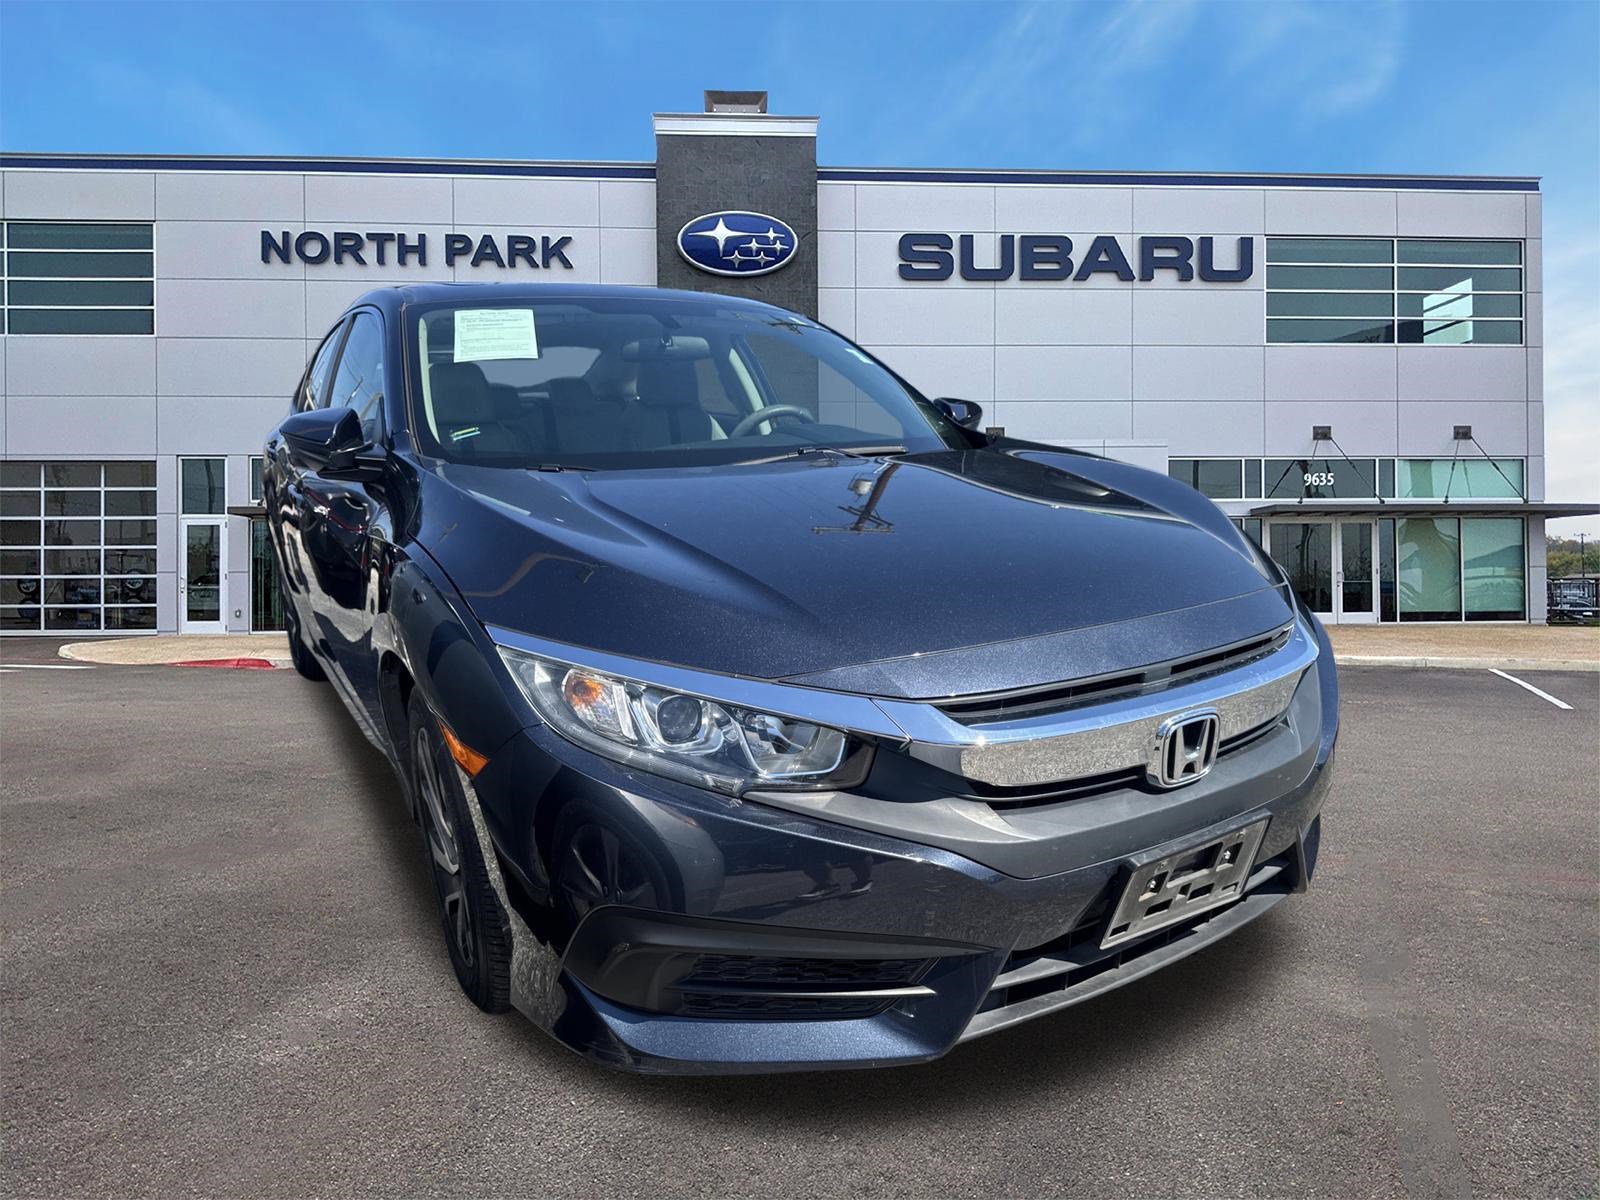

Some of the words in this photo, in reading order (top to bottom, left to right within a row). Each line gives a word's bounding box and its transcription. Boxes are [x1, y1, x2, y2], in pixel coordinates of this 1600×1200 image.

[260, 230, 427, 267] NORTH
[445, 233, 574, 270] PARK
[898, 233, 1254, 282] SUBARU
[1303, 472, 1335, 486] 9635
